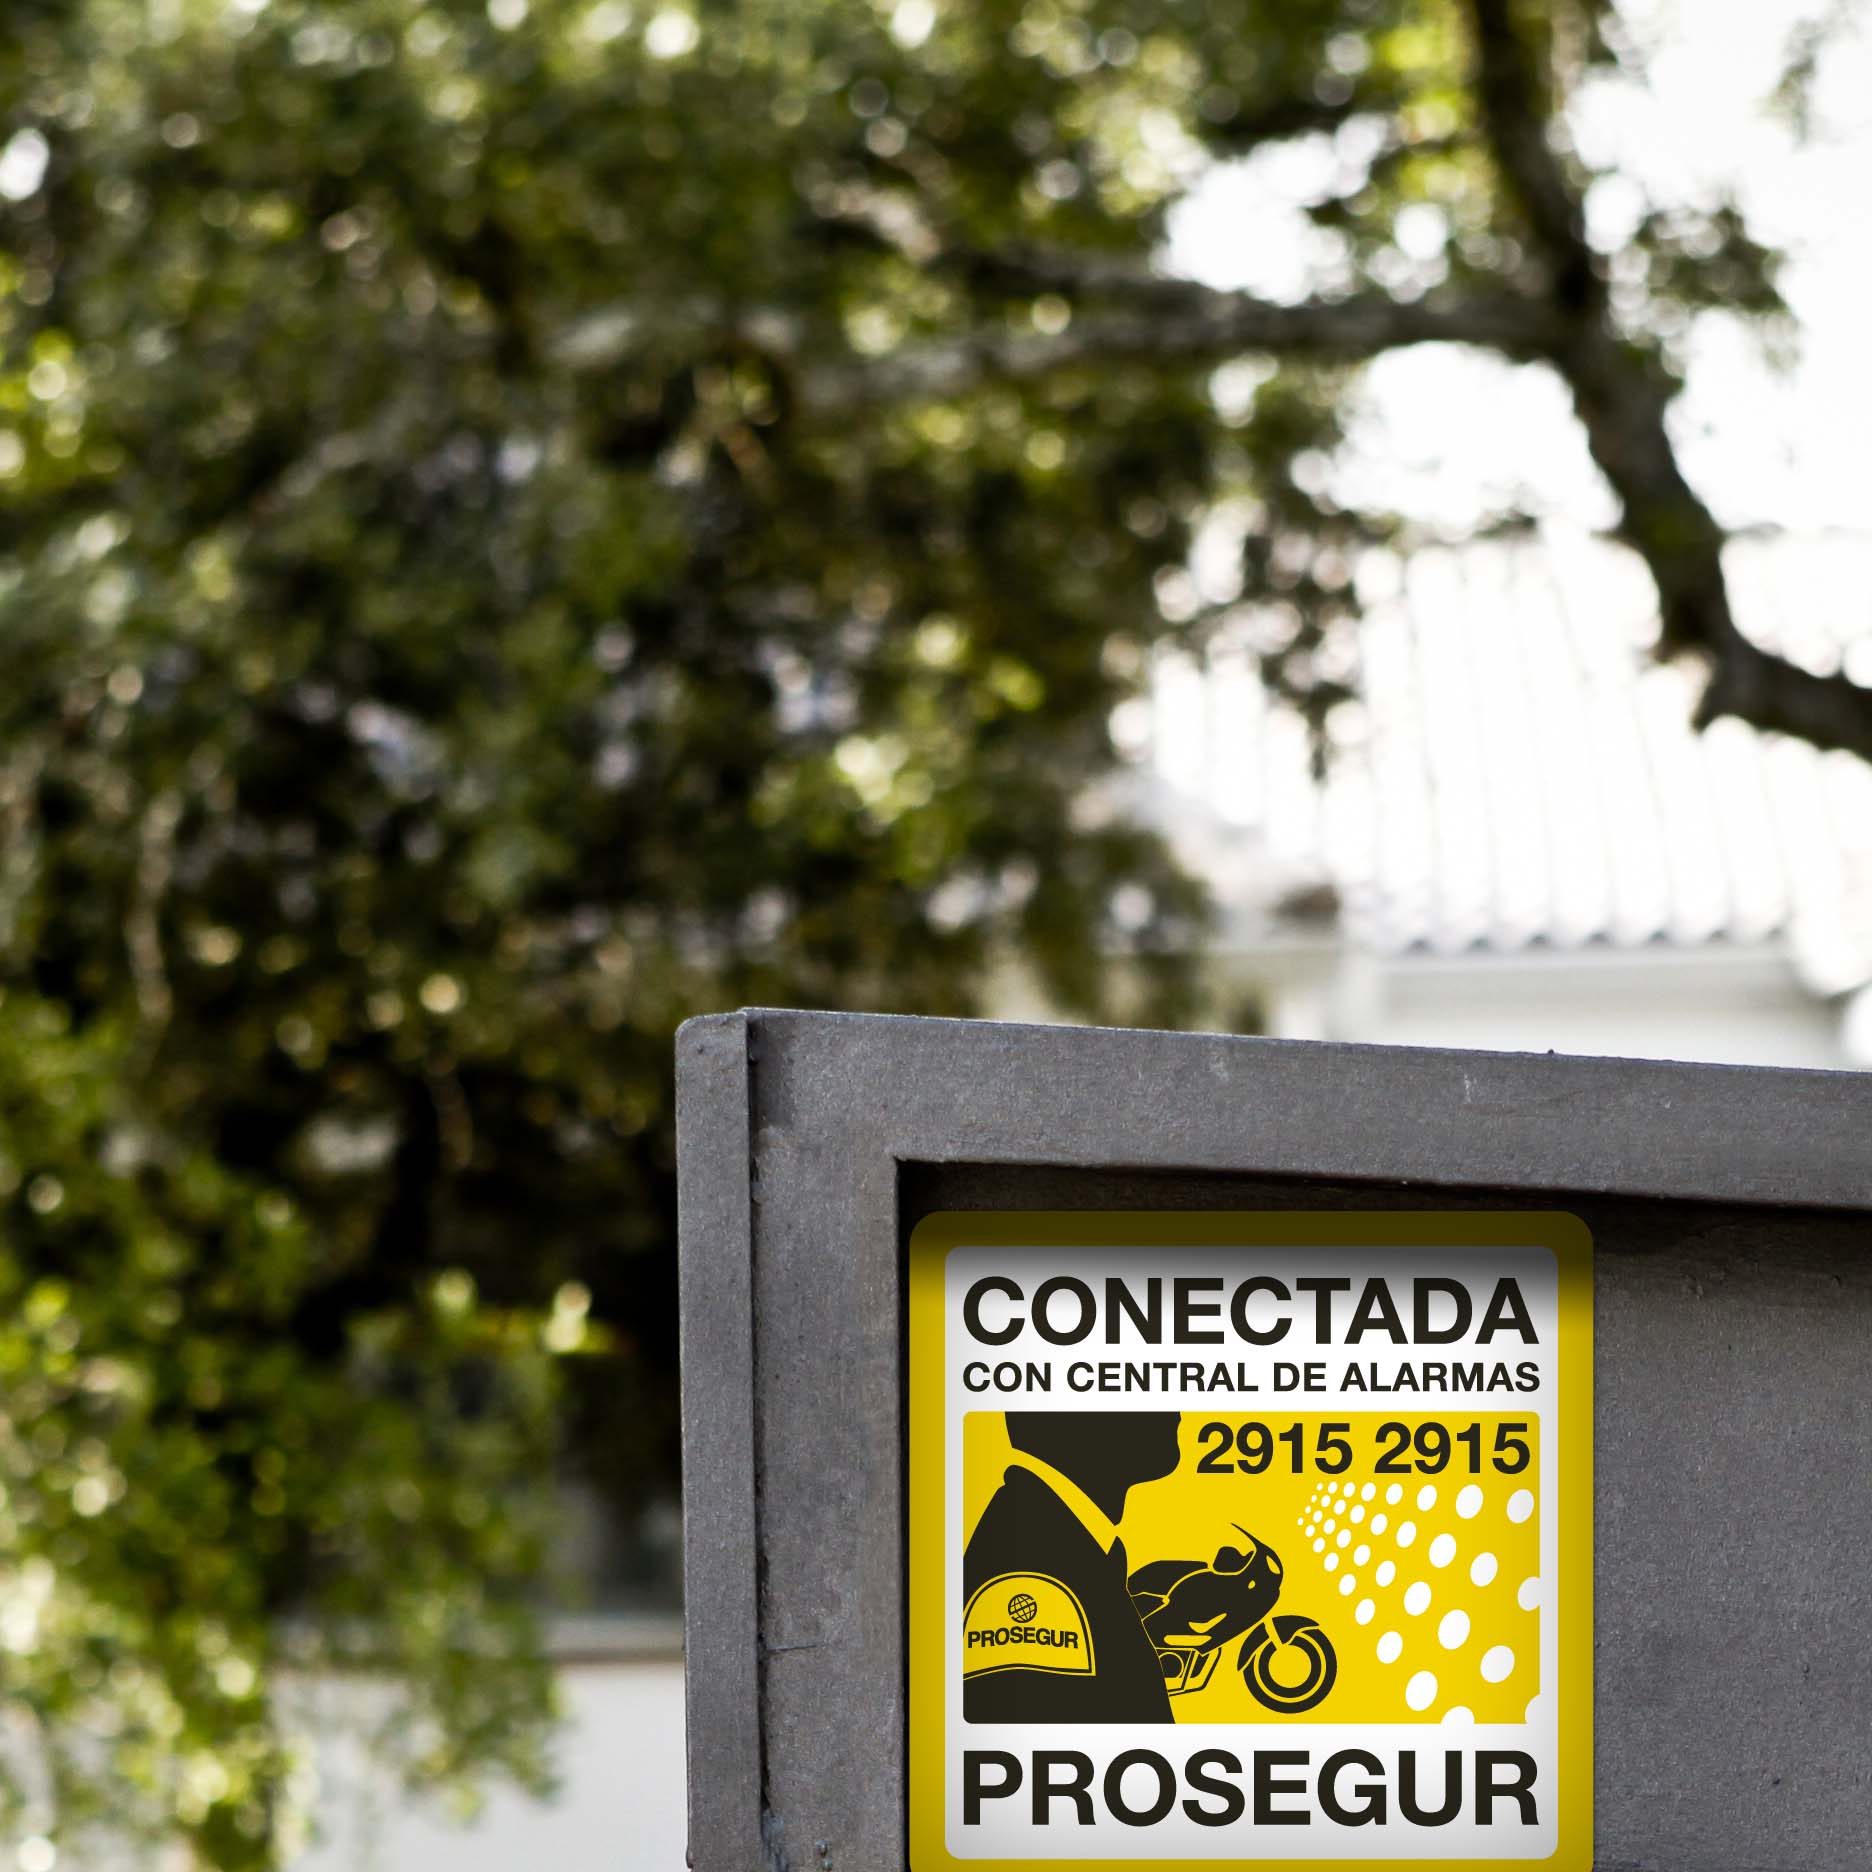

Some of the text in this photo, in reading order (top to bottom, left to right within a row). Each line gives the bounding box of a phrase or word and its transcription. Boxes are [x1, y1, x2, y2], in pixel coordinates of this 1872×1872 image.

[963, 1276, 1540, 1346] CONECTADA
[963, 1362, 1539, 1392] CON CENTRAL DE ALARMAS
[1197, 1423, 1529, 1474] 2915 2915
[968, 1626, 1078, 1648] PROSEGUR
[964, 1749, 1538, 1826] PROSEGUR
